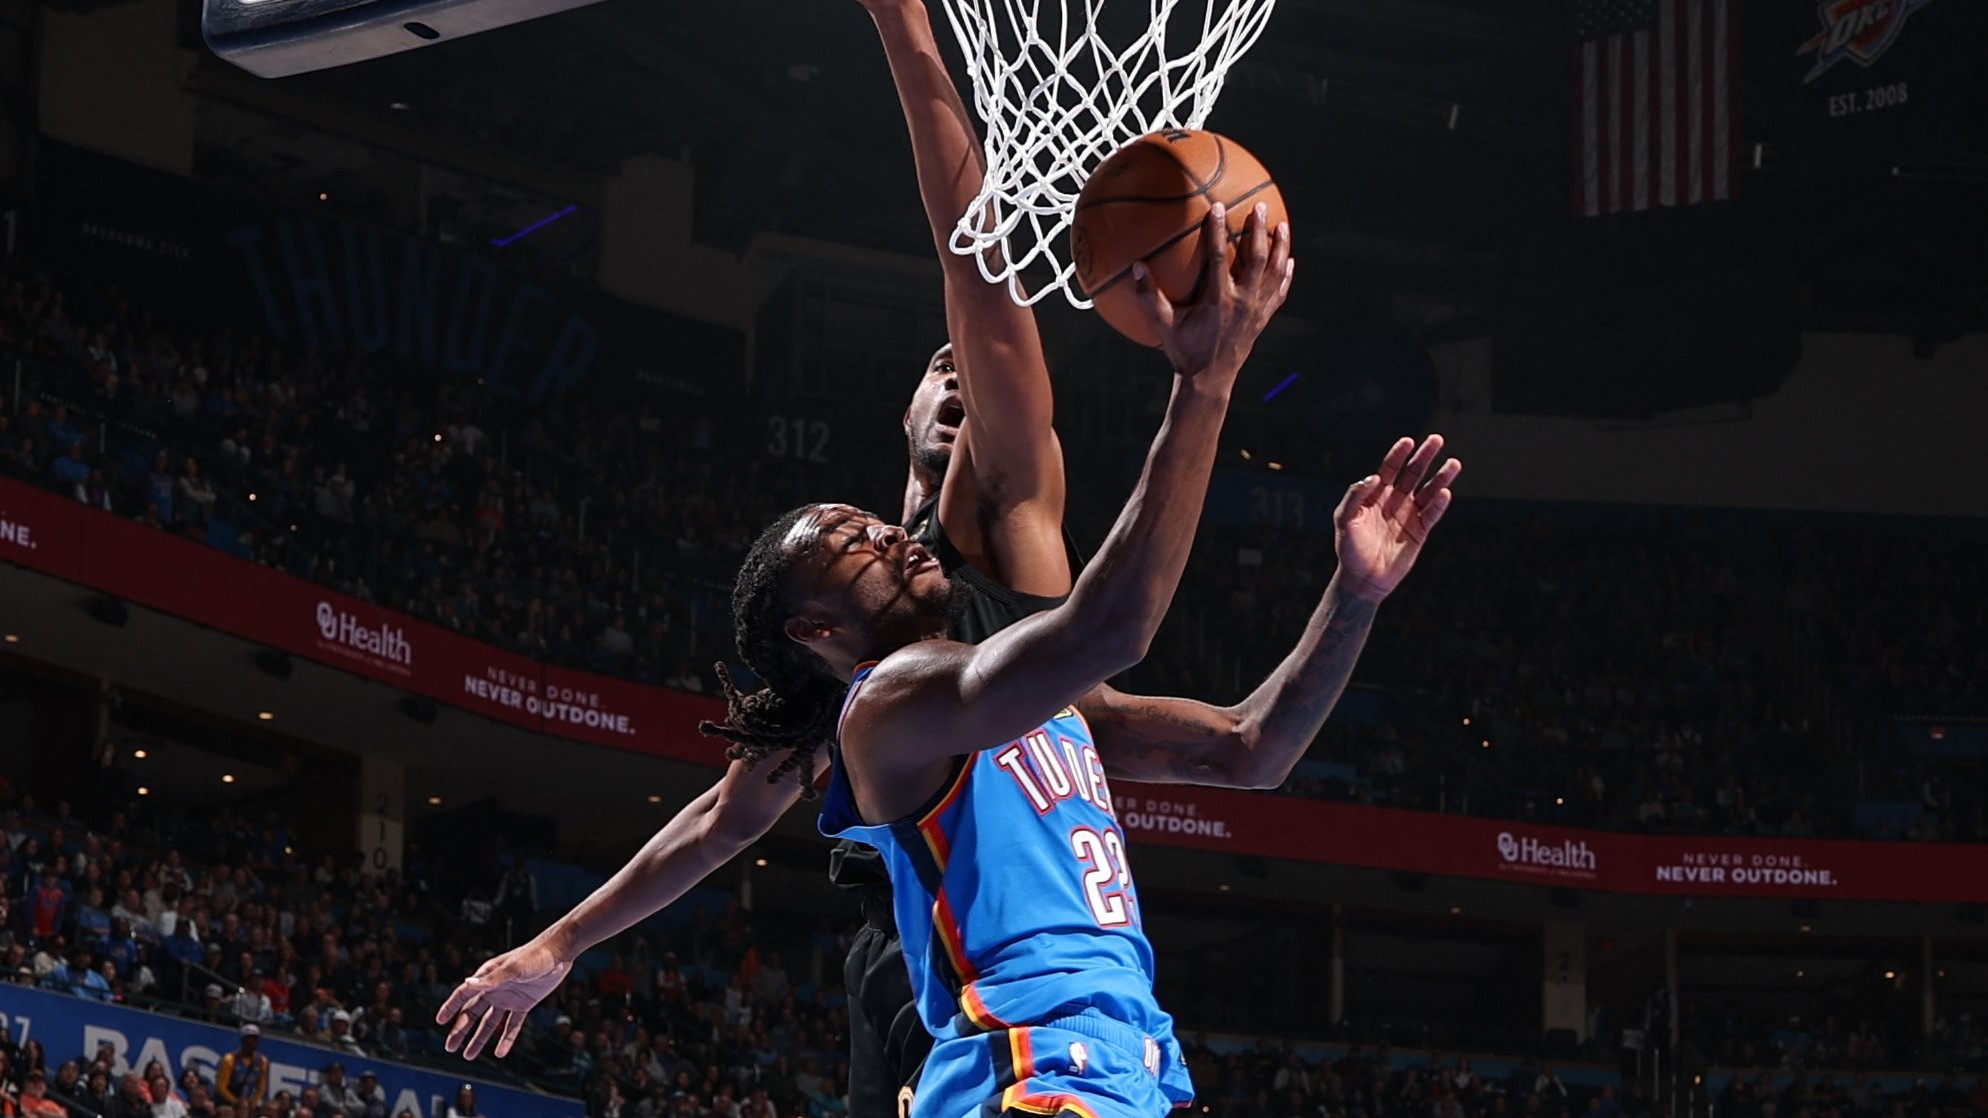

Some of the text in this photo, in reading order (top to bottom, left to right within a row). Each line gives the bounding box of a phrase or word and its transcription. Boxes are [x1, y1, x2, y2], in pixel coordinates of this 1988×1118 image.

[1829, 81, 1908, 118] EST. 2008
[223, 217, 602, 406] THUNDER
[767, 414, 831, 463] 312
[339, 611, 412, 666] Health
[464, 674, 637, 735] NEVER OUTDONE.
[487, 665, 607, 709] NEVER DONE.
[1125, 811, 1232, 838] OUTDONE.
[1521, 836, 1597, 870] Health
[1682, 853, 1743, 867] NEVER
[1656, 865, 1838, 886] NEVER OUTDONE.
